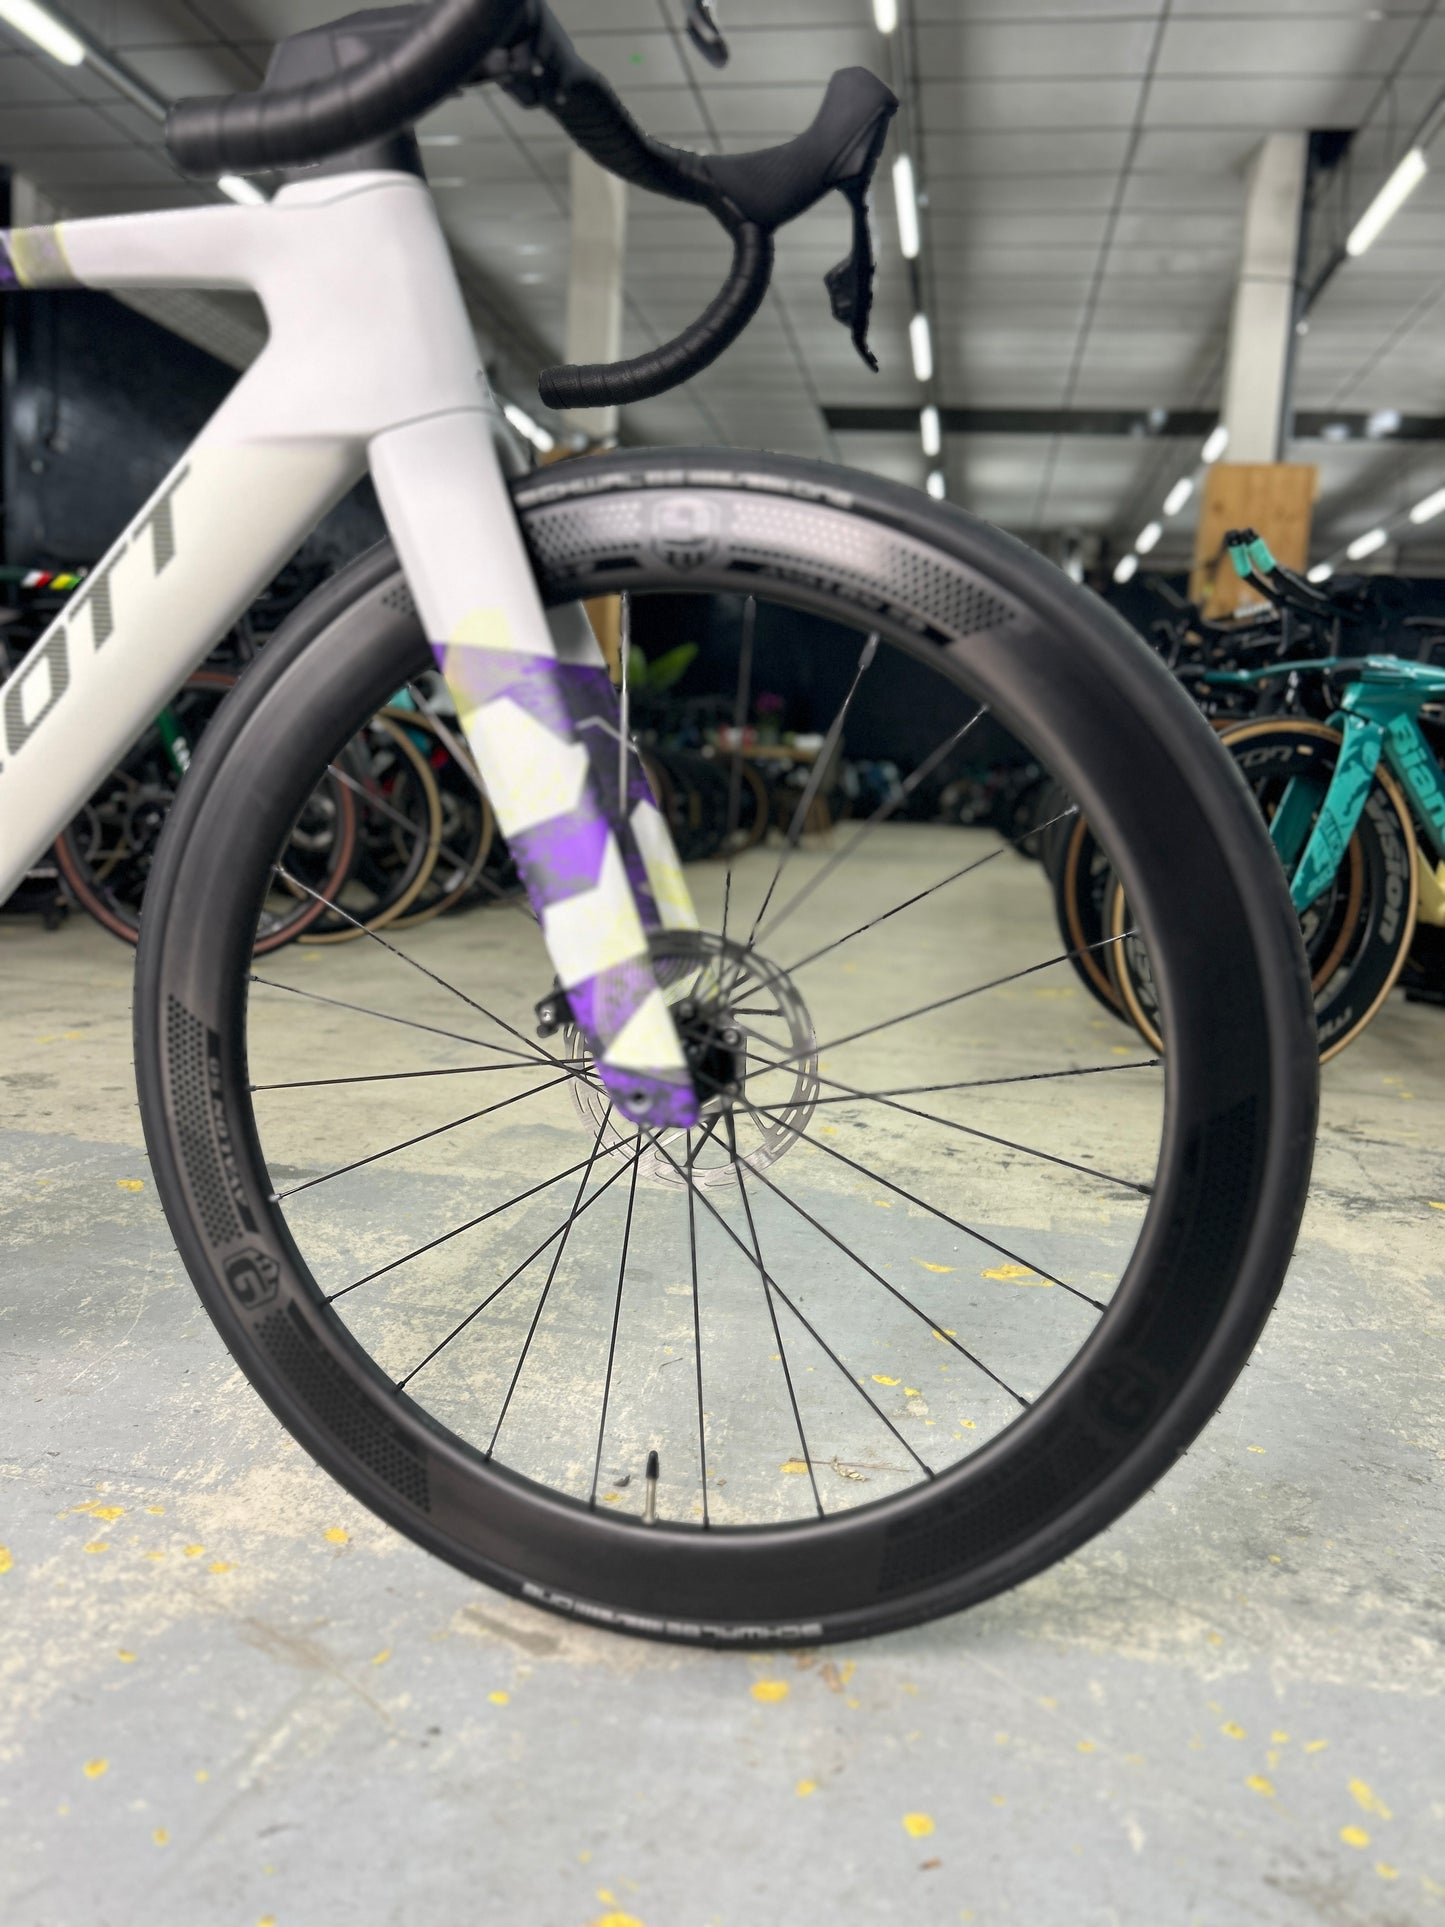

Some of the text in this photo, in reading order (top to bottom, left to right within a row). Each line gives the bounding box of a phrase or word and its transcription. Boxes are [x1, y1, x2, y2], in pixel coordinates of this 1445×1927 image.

[515, 471, 685, 506] SCHWALBE
[0, 463, 191, 773] OTT
[1388, 713, 1445, 844] Bian
[666, 1620, 823, 1640] SCHWALBE
